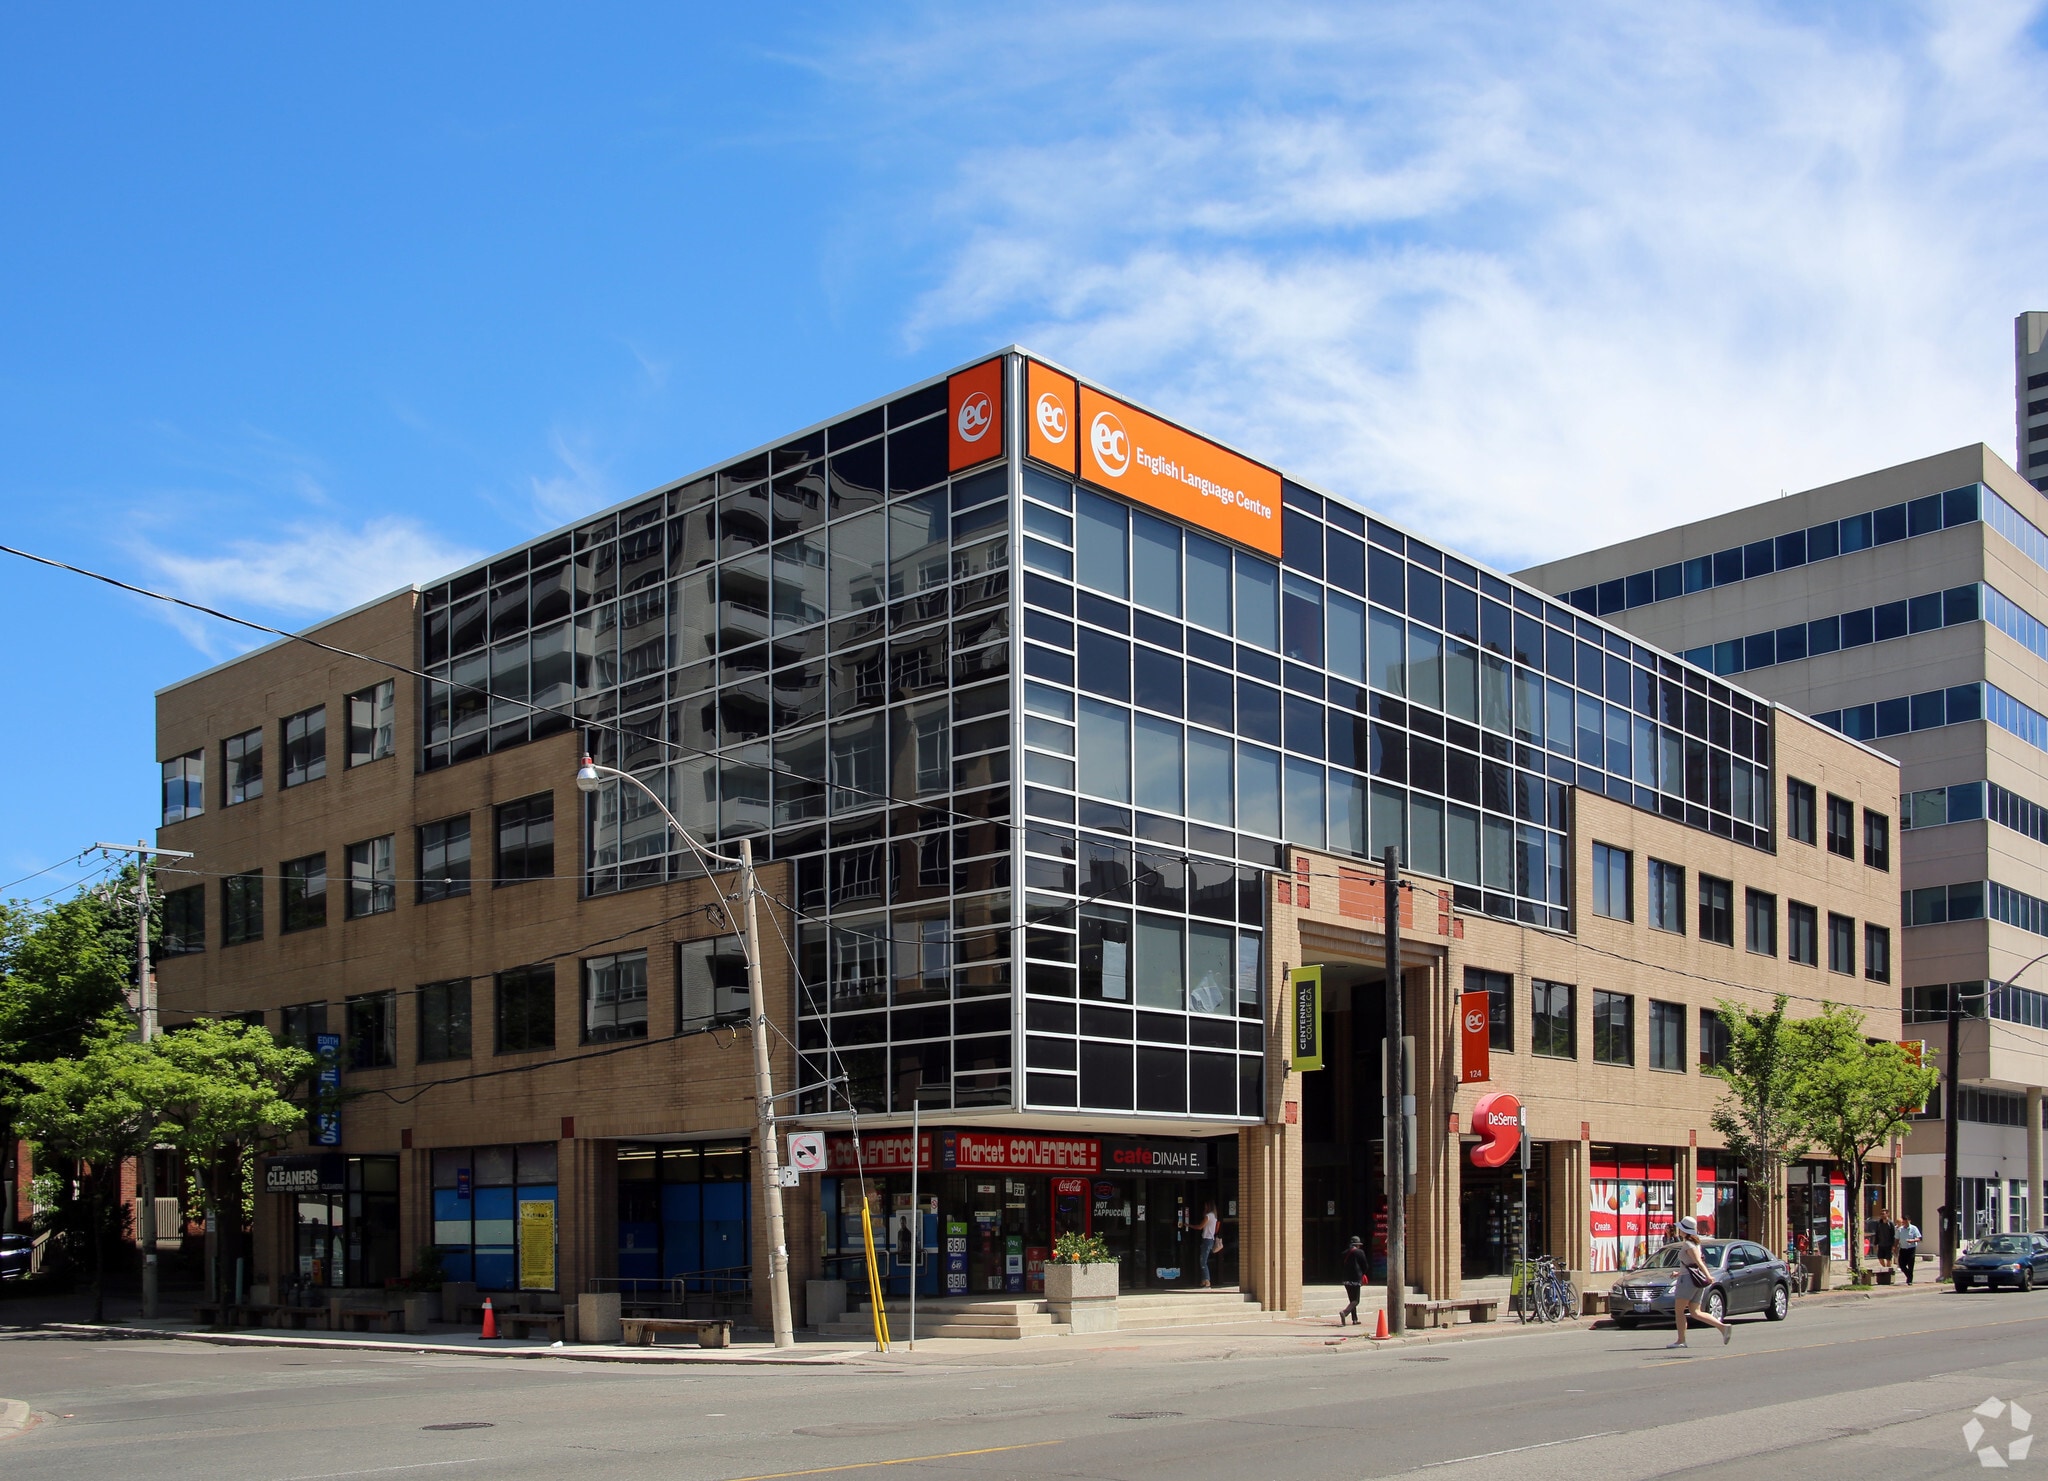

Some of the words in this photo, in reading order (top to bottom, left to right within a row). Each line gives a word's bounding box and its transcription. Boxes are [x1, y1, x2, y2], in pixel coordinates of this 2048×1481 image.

[960, 400, 989, 430] ec
[1036, 401, 1064, 432] ec
[1097, 423, 1126, 462] ec
[1136, 447, 1179, 480] English
[1181, 468, 1234, 505] Language
[1236, 491, 1272, 519] Centre
[317, 1036, 339, 1045] EDITH
[1470, 1070, 1482, 1078] 124
[1488, 1112, 1518, 1126] DeSerre
[960, 1137, 1005, 1163] Market
[1010, 1139, 1087, 1166] CONVENIENCE
[1113, 1146, 1152, 1165] café
[1152, 1151, 1187, 1166] DINAH
[1190, 1153, 1200, 1167] E.
[267, 1169, 319, 1186] CLEANERS
[1095, 1201, 1108, 1209] HOT
[1594, 1222, 1612, 1231] Create.
[1626, 1221, 1638, 1232] Play.
[1649, 1221, 1669, 1229] Decorat
[1027, 1260, 1045, 1271] ATM
